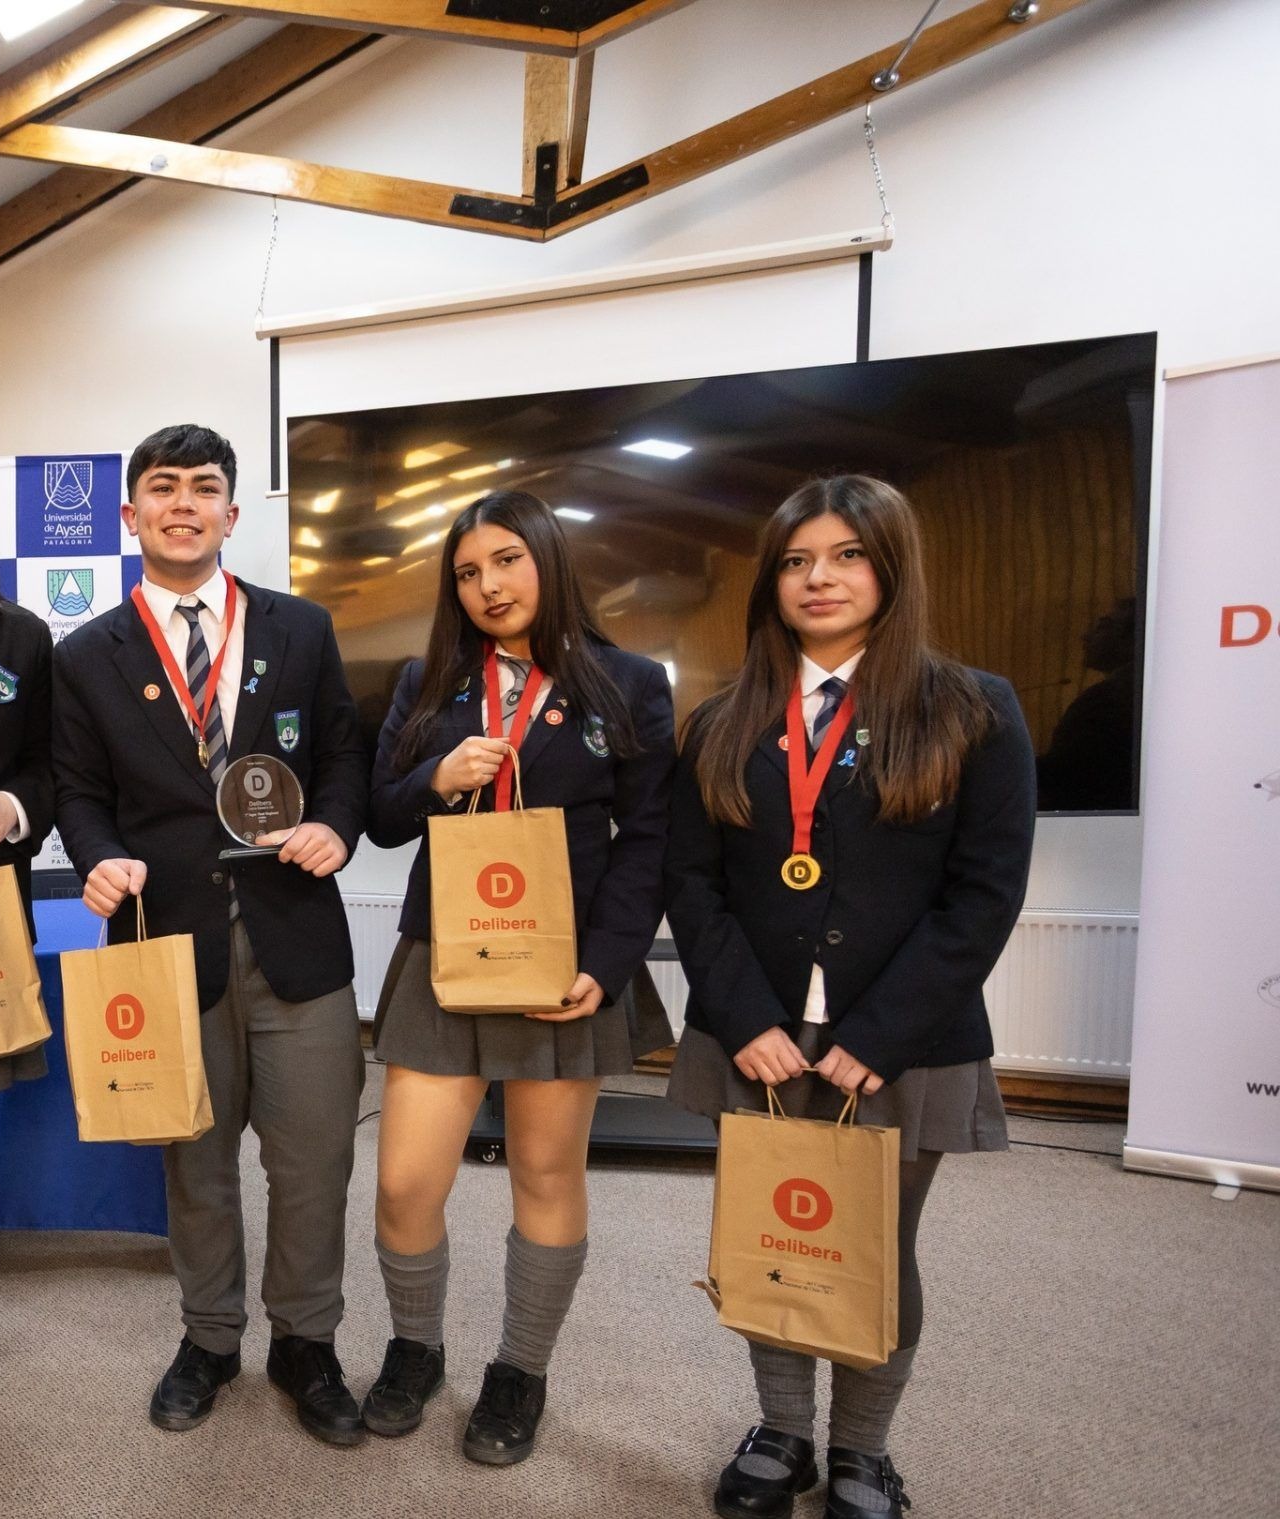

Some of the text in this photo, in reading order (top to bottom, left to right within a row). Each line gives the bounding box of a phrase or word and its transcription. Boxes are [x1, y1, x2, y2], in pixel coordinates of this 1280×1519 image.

[44, 513, 92, 522] Universidad
[44, 522, 92, 538] de Aysén
[1220, 604, 1280, 648] D
[252, 775, 265, 791] D
[51, 843, 61, 851] de
[794, 866, 806, 878] D
[491, 873, 514, 898] D
[469, 918, 537, 931] Delibera
[116, 1004, 135, 1030] D
[101, 1048, 156, 1063] Delibera
[790, 1189, 818, 1219] D
[760, 1233, 842, 1263] Delibera
